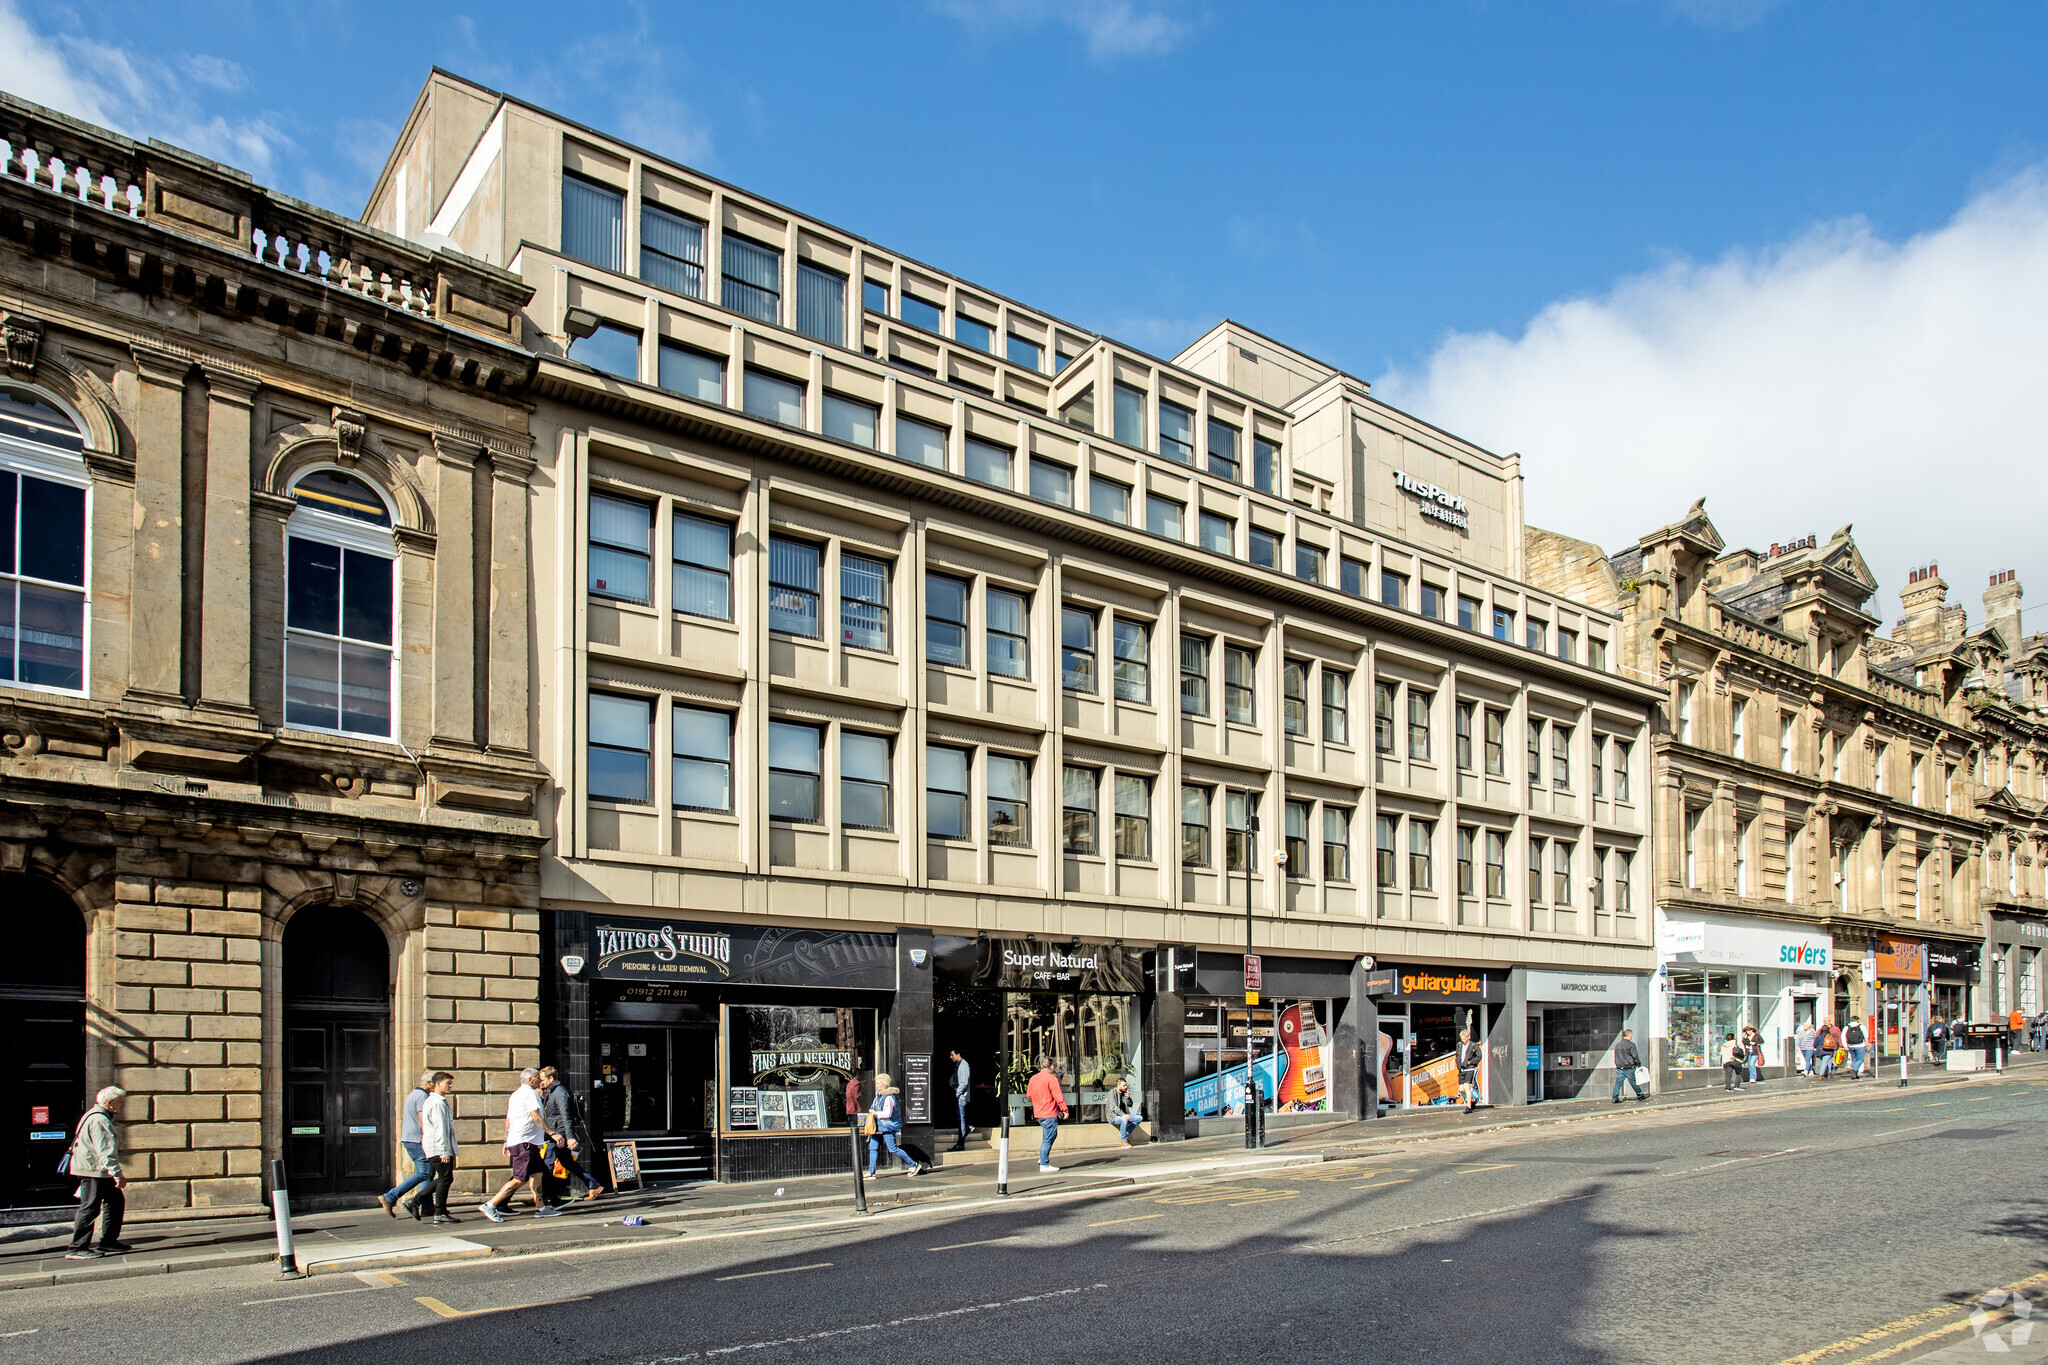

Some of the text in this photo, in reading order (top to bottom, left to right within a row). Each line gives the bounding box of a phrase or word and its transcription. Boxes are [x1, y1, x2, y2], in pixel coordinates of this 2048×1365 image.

[1393, 469, 1466, 512] TusPark
[597, 925, 730, 963] TATTOO STUDIO
[1677, 934, 1702, 942] savers
[1004, 950, 1098, 970] Super Natural
[1780, 941, 1826, 965] savers
[658, 963, 678, 972] LASER
[679, 964, 708, 974] REMOVAL
[1033, 971, 1070, 981] CAFE BAR
[627, 988, 655, 996] 01912
[1402, 971, 1481, 995] guitarguitar.
[1560, 983, 1607, 992] MAYBROOK HOUSE
[752, 1052, 851, 1074] PINS AND NEEDLES
[1437, 1062, 1450, 1076] SELL
[1092, 1094, 1106, 1102] CAF
[1186, 1083, 1214, 1103] ASTLE'S
[1198, 1096, 1221, 1112] RANG
[1224, 1089, 1232, 1103] OF
